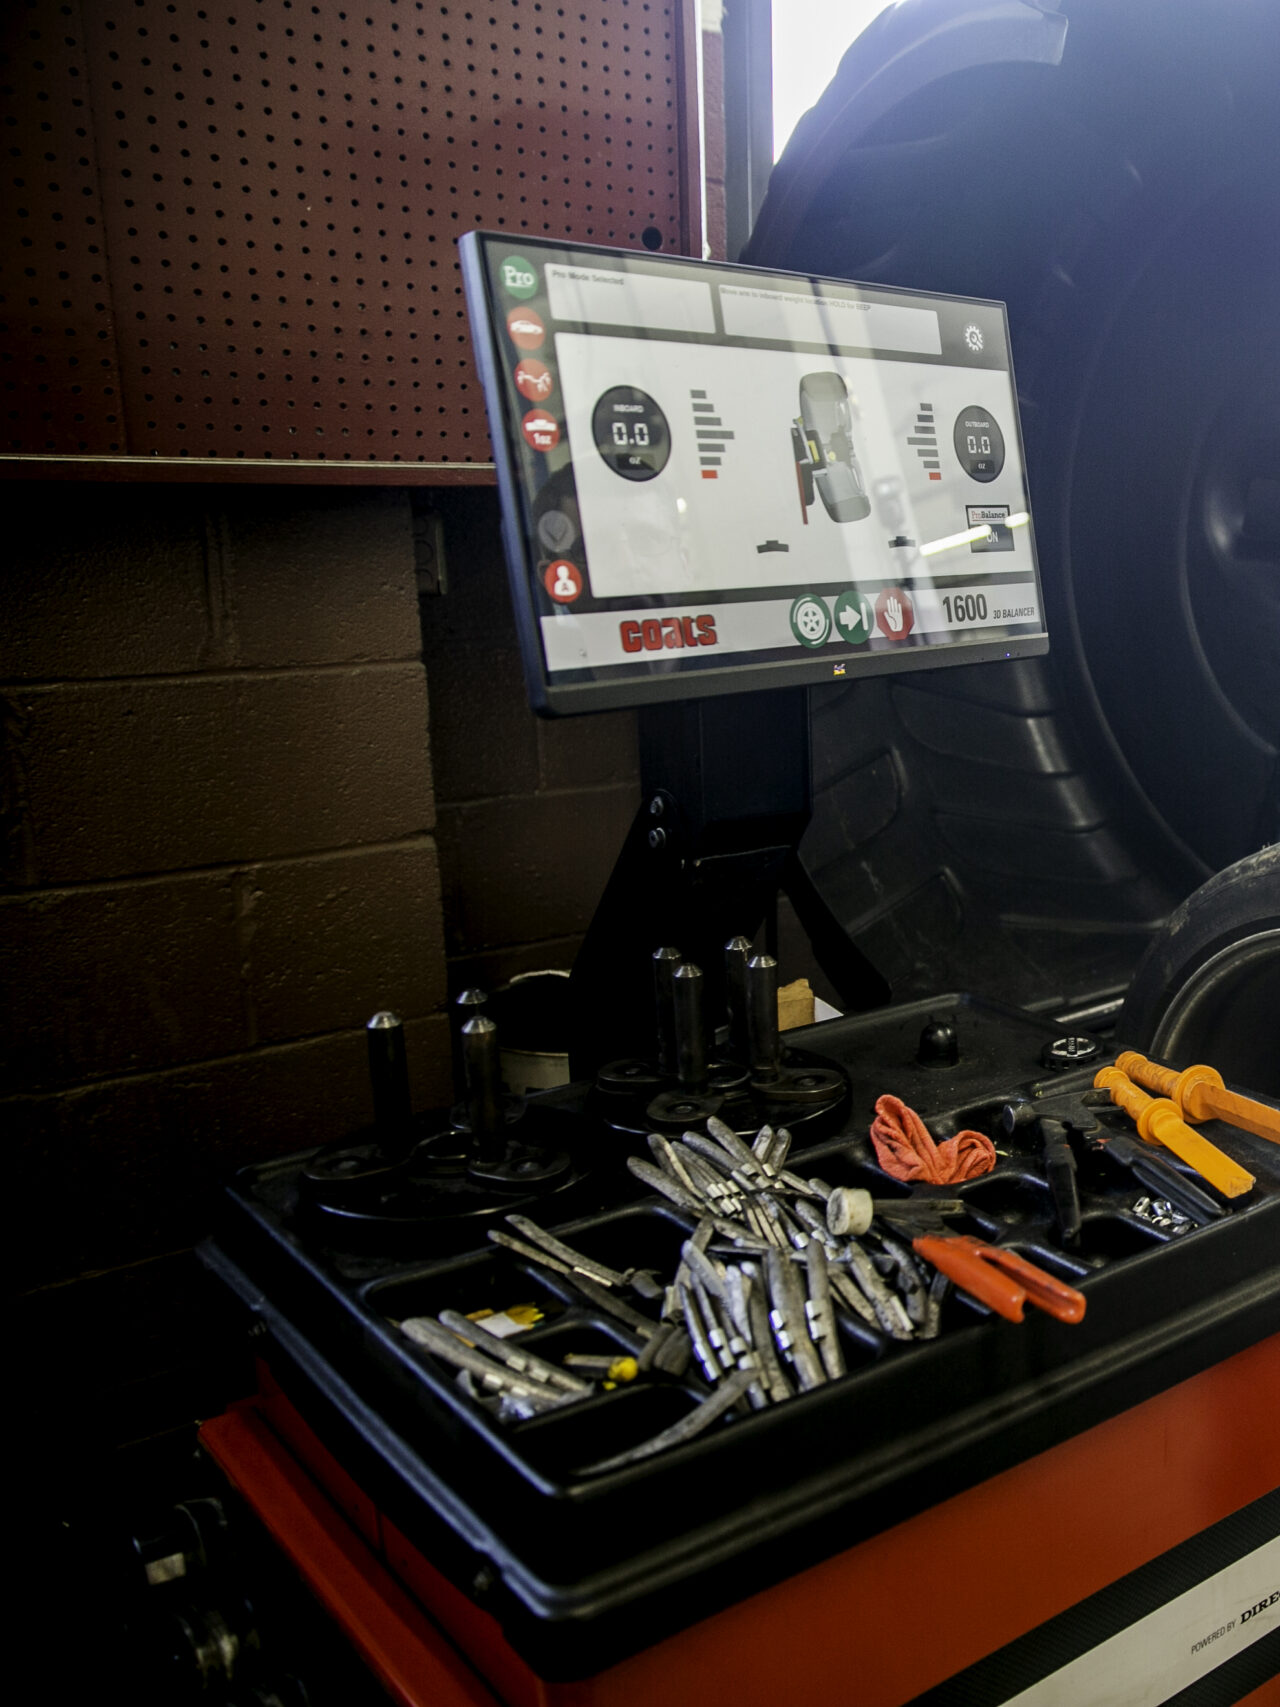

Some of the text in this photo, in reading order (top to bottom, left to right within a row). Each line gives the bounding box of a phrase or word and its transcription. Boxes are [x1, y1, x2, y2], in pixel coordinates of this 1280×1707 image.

[502, 265, 535, 288] Pro
[552, 269, 625, 286] Pro Mode Selected
[612, 404, 644, 413] INBOARD
[612, 421, 650, 446] 0.0
[965, 421, 990, 429] OUTBOARD
[967, 435, 991, 455] 0.0
[971, 510, 1005, 519] ProBalance
[986, 531, 999, 543] ON
[942, 593, 1035, 623] 1600 3D BALANCER
[1191, 1625, 1226, 1655] POWERED
[1226, 1619, 1236, 1632] BY
